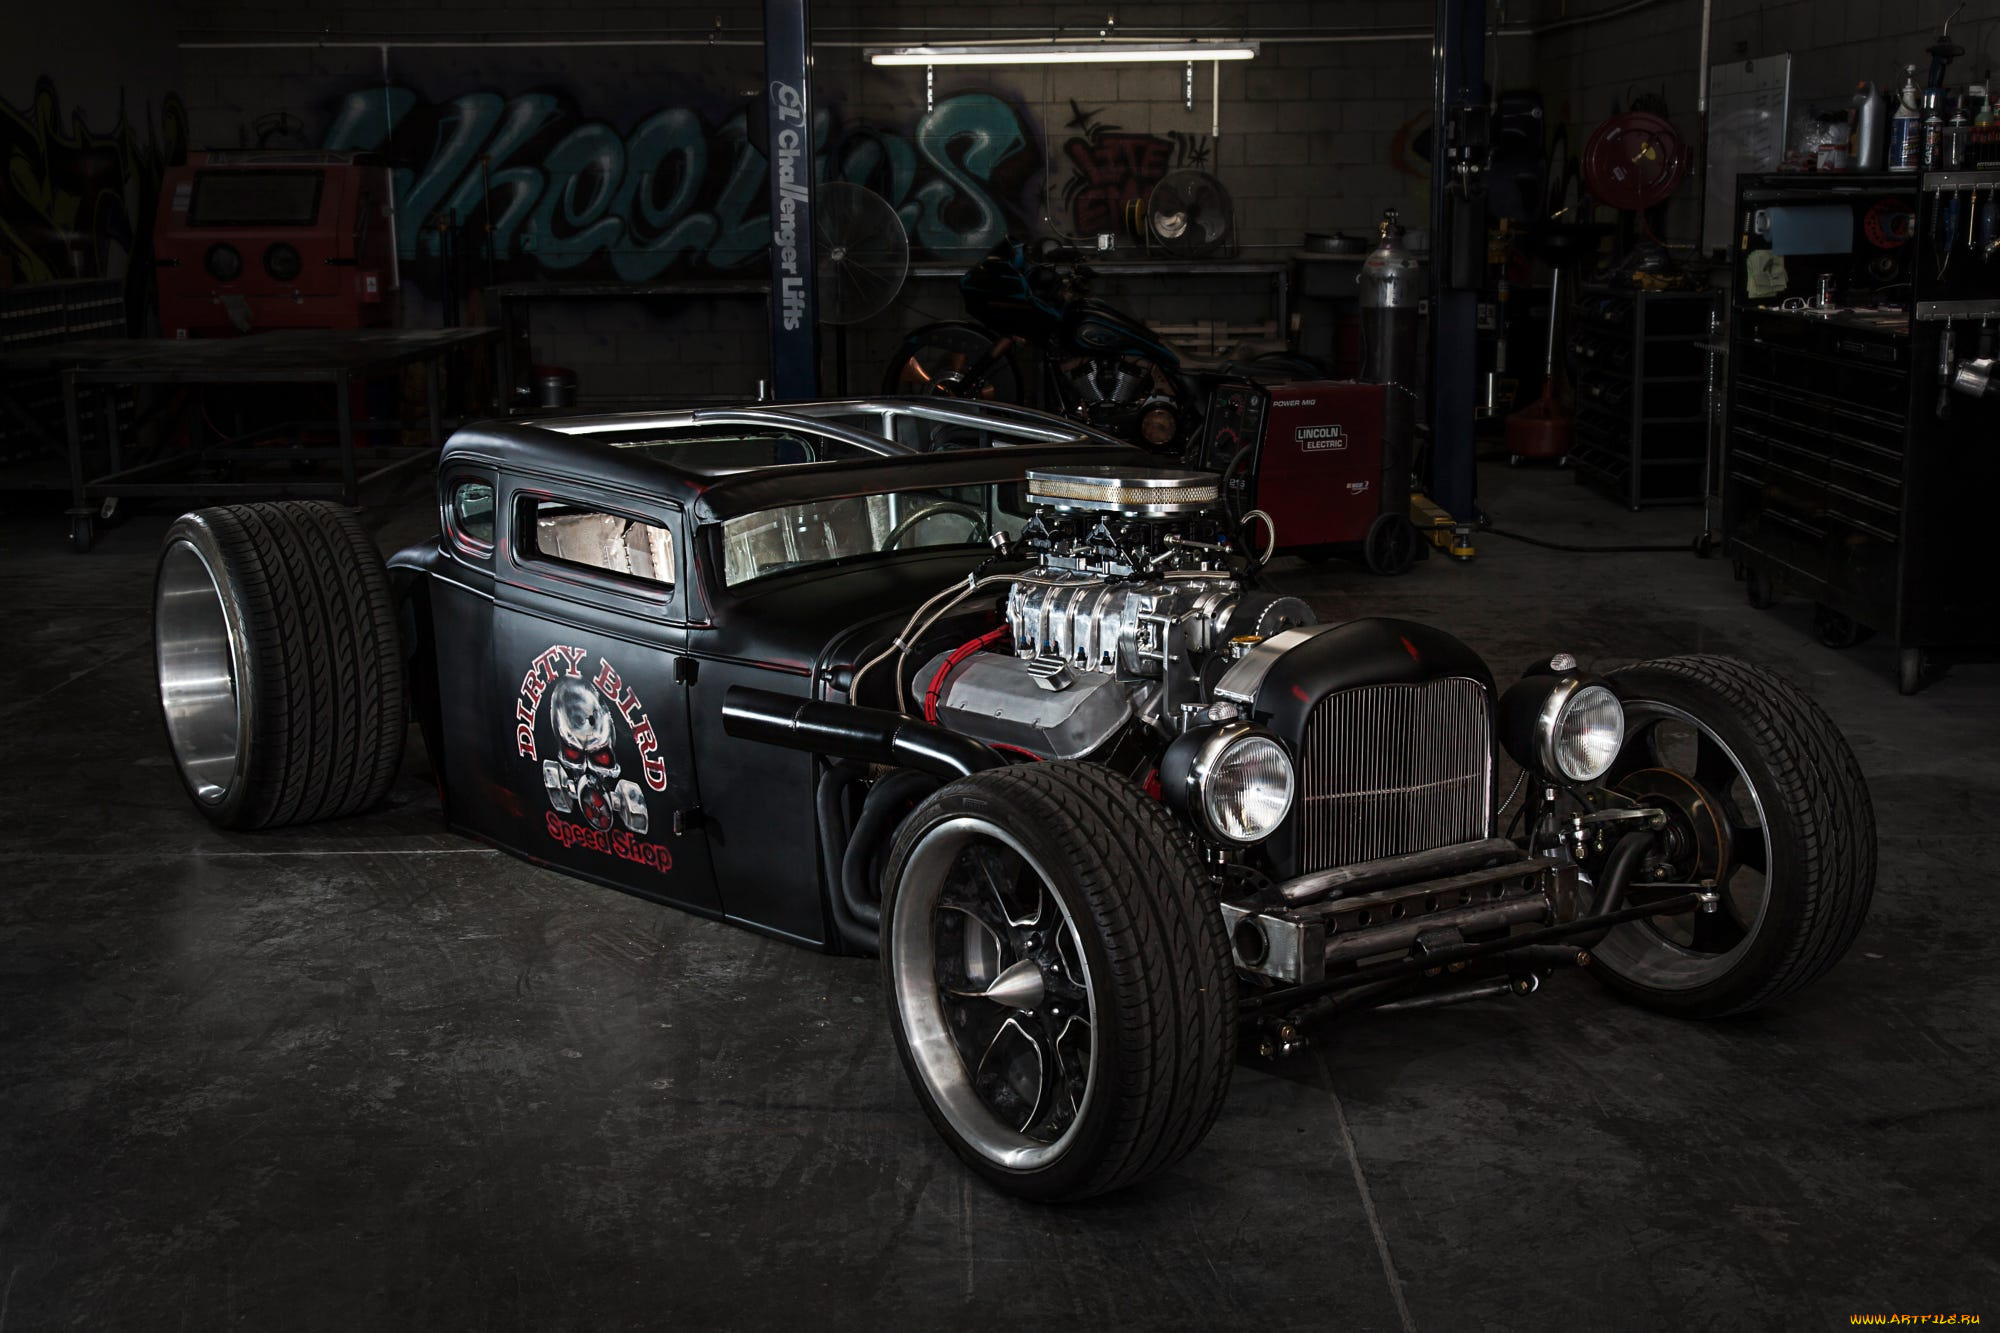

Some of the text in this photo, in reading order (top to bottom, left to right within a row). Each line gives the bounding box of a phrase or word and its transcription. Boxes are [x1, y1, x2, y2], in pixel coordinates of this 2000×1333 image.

[774, 128, 809, 275] Challenger
[782, 276, 806, 332] Lifts
[1272, 398, 1316, 408] POWER MIG
[1297, 427, 1339, 440] LINCOLN
[1307, 439, 1343, 449] ELECTRIC
[516, 644, 668, 793] DIRTY BIRD
[545, 809, 673, 873] Speed Shop
